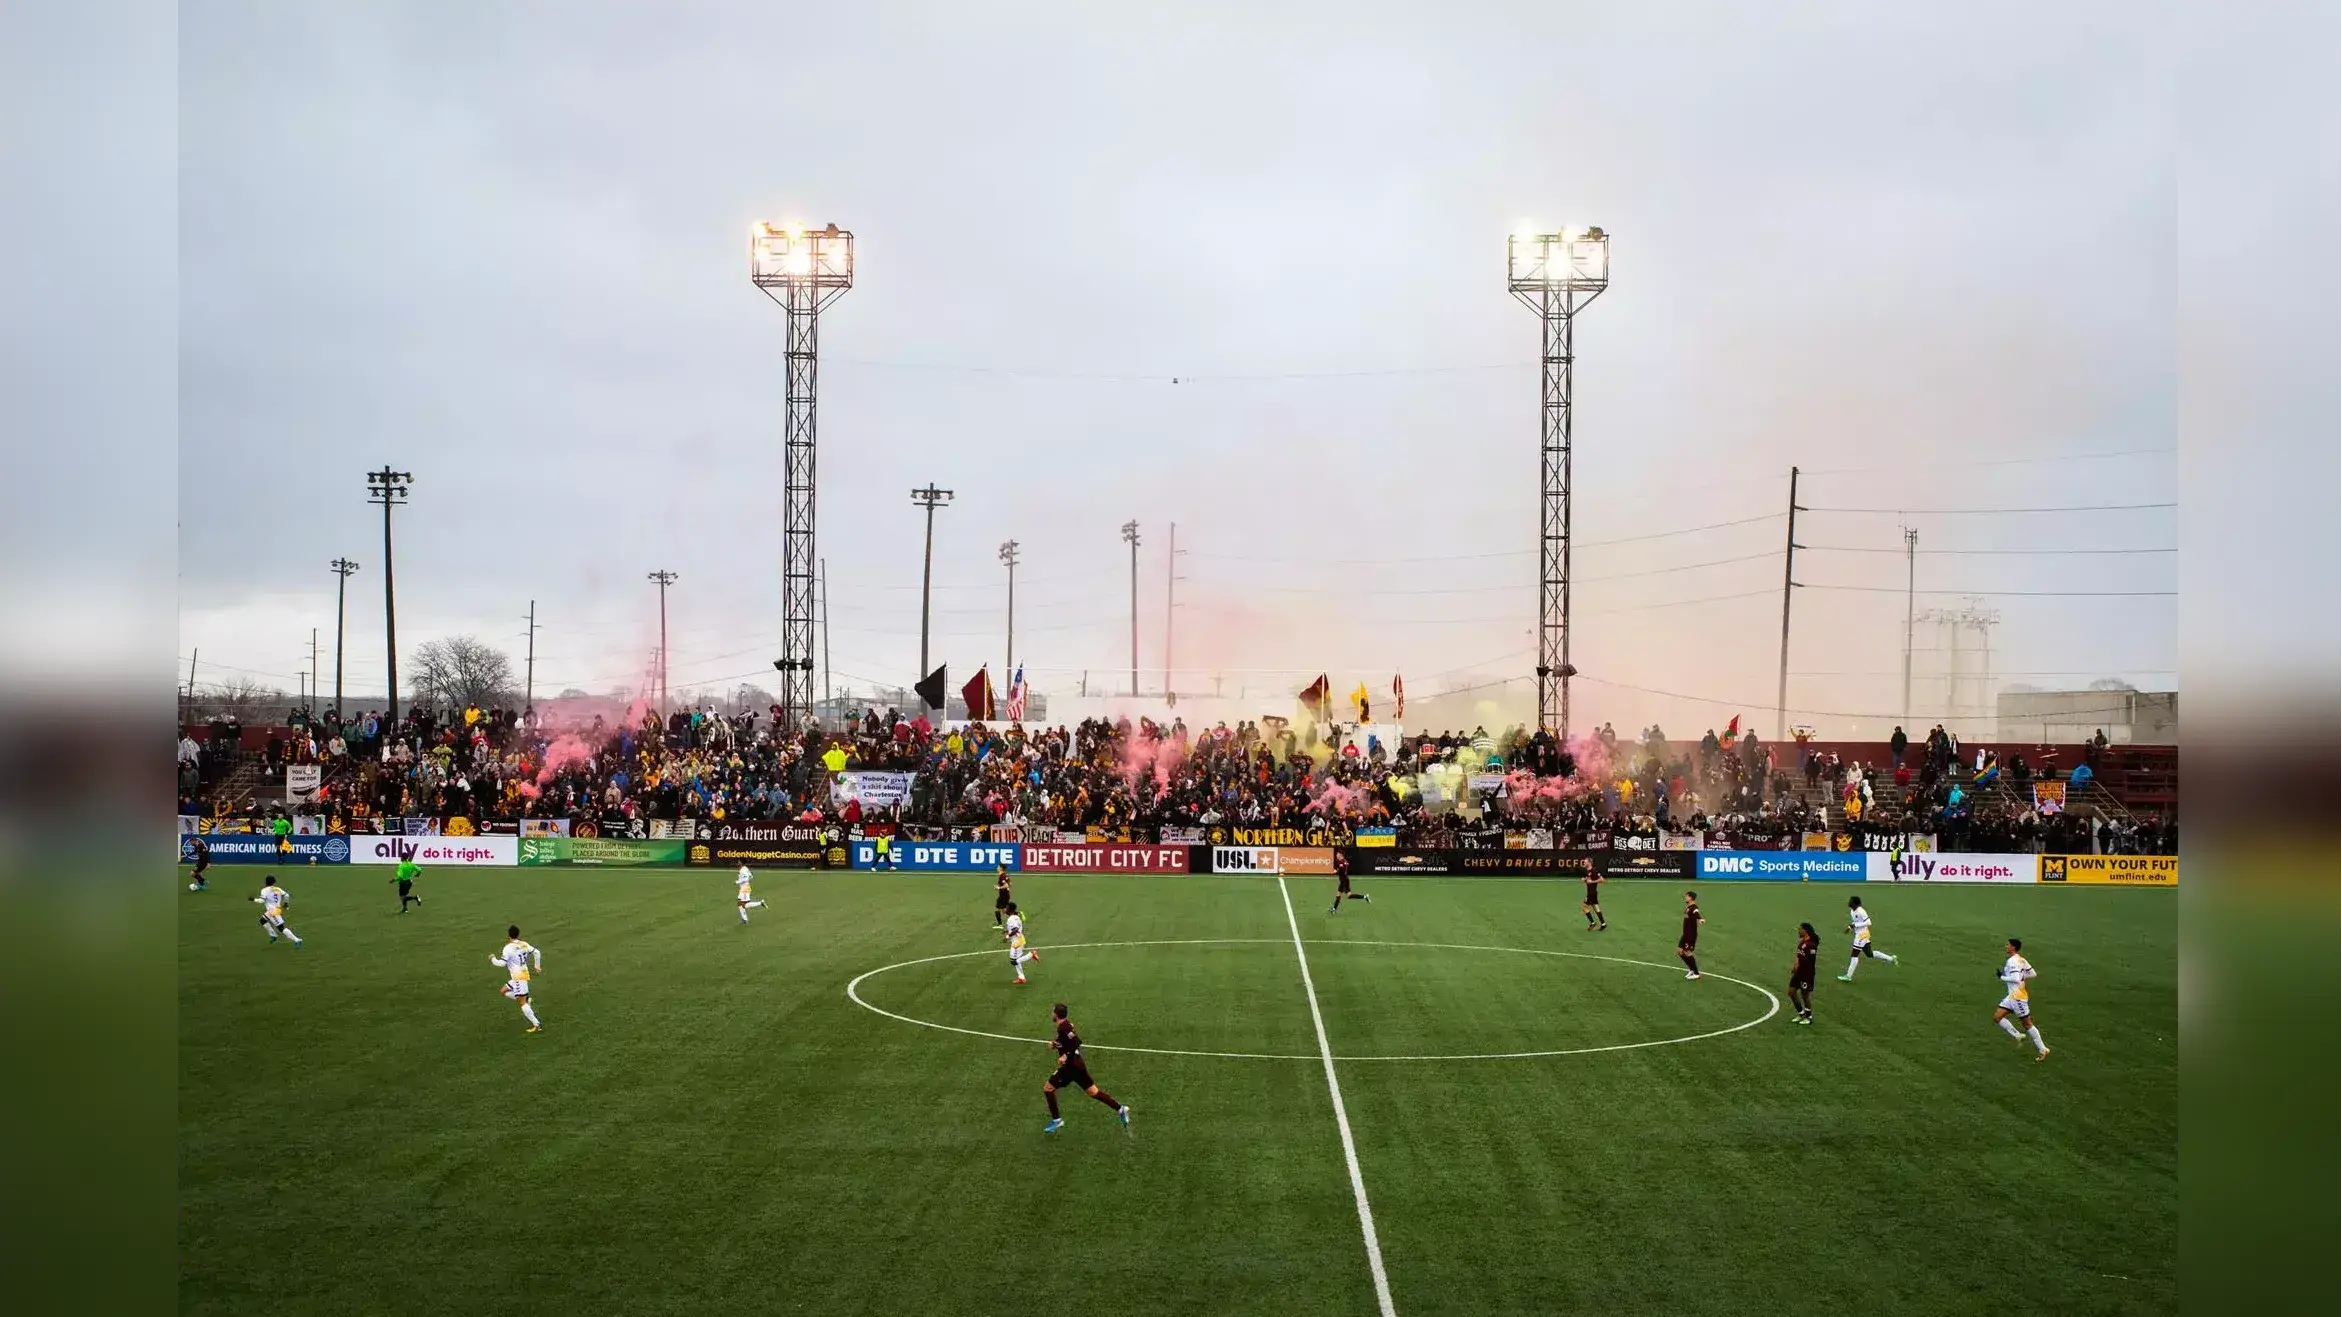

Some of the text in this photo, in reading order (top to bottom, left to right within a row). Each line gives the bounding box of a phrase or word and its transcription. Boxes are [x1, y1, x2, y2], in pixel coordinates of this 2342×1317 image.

[1233, 826, 1304, 846] NORTHERN
[209, 843, 256, 854] AMERICAN
[258, 843, 284, 854] HOM
[287, 844, 322, 854] ITNESS
[375, 838, 494, 862] ally do it right.
[572, 842, 600, 850] POWERED
[1643, 839, 1656, 849] DET
[596, 850, 618, 858] AROUND
[620, 850, 630, 858] THE
[717, 850, 820, 860] GoldenNuggetCasino.com
[915, 847, 957, 864] DTE
[970, 848, 1013, 864] DTE
[1026, 848, 1183, 867] DETROIT CITY FC
[1216, 850, 1331, 869] USL Championship
[1464, 858, 1500, 867] CHEVY
[1506, 859, 1551, 867] DRIVES
[1704, 857, 1860, 873] DMC Sports Medicine
[1896, 855, 2013, 880] ally do it right.
[2070, 858, 2177, 871] OWN YOUR FUT
[2109, 872, 2167, 881] umflint.edu
